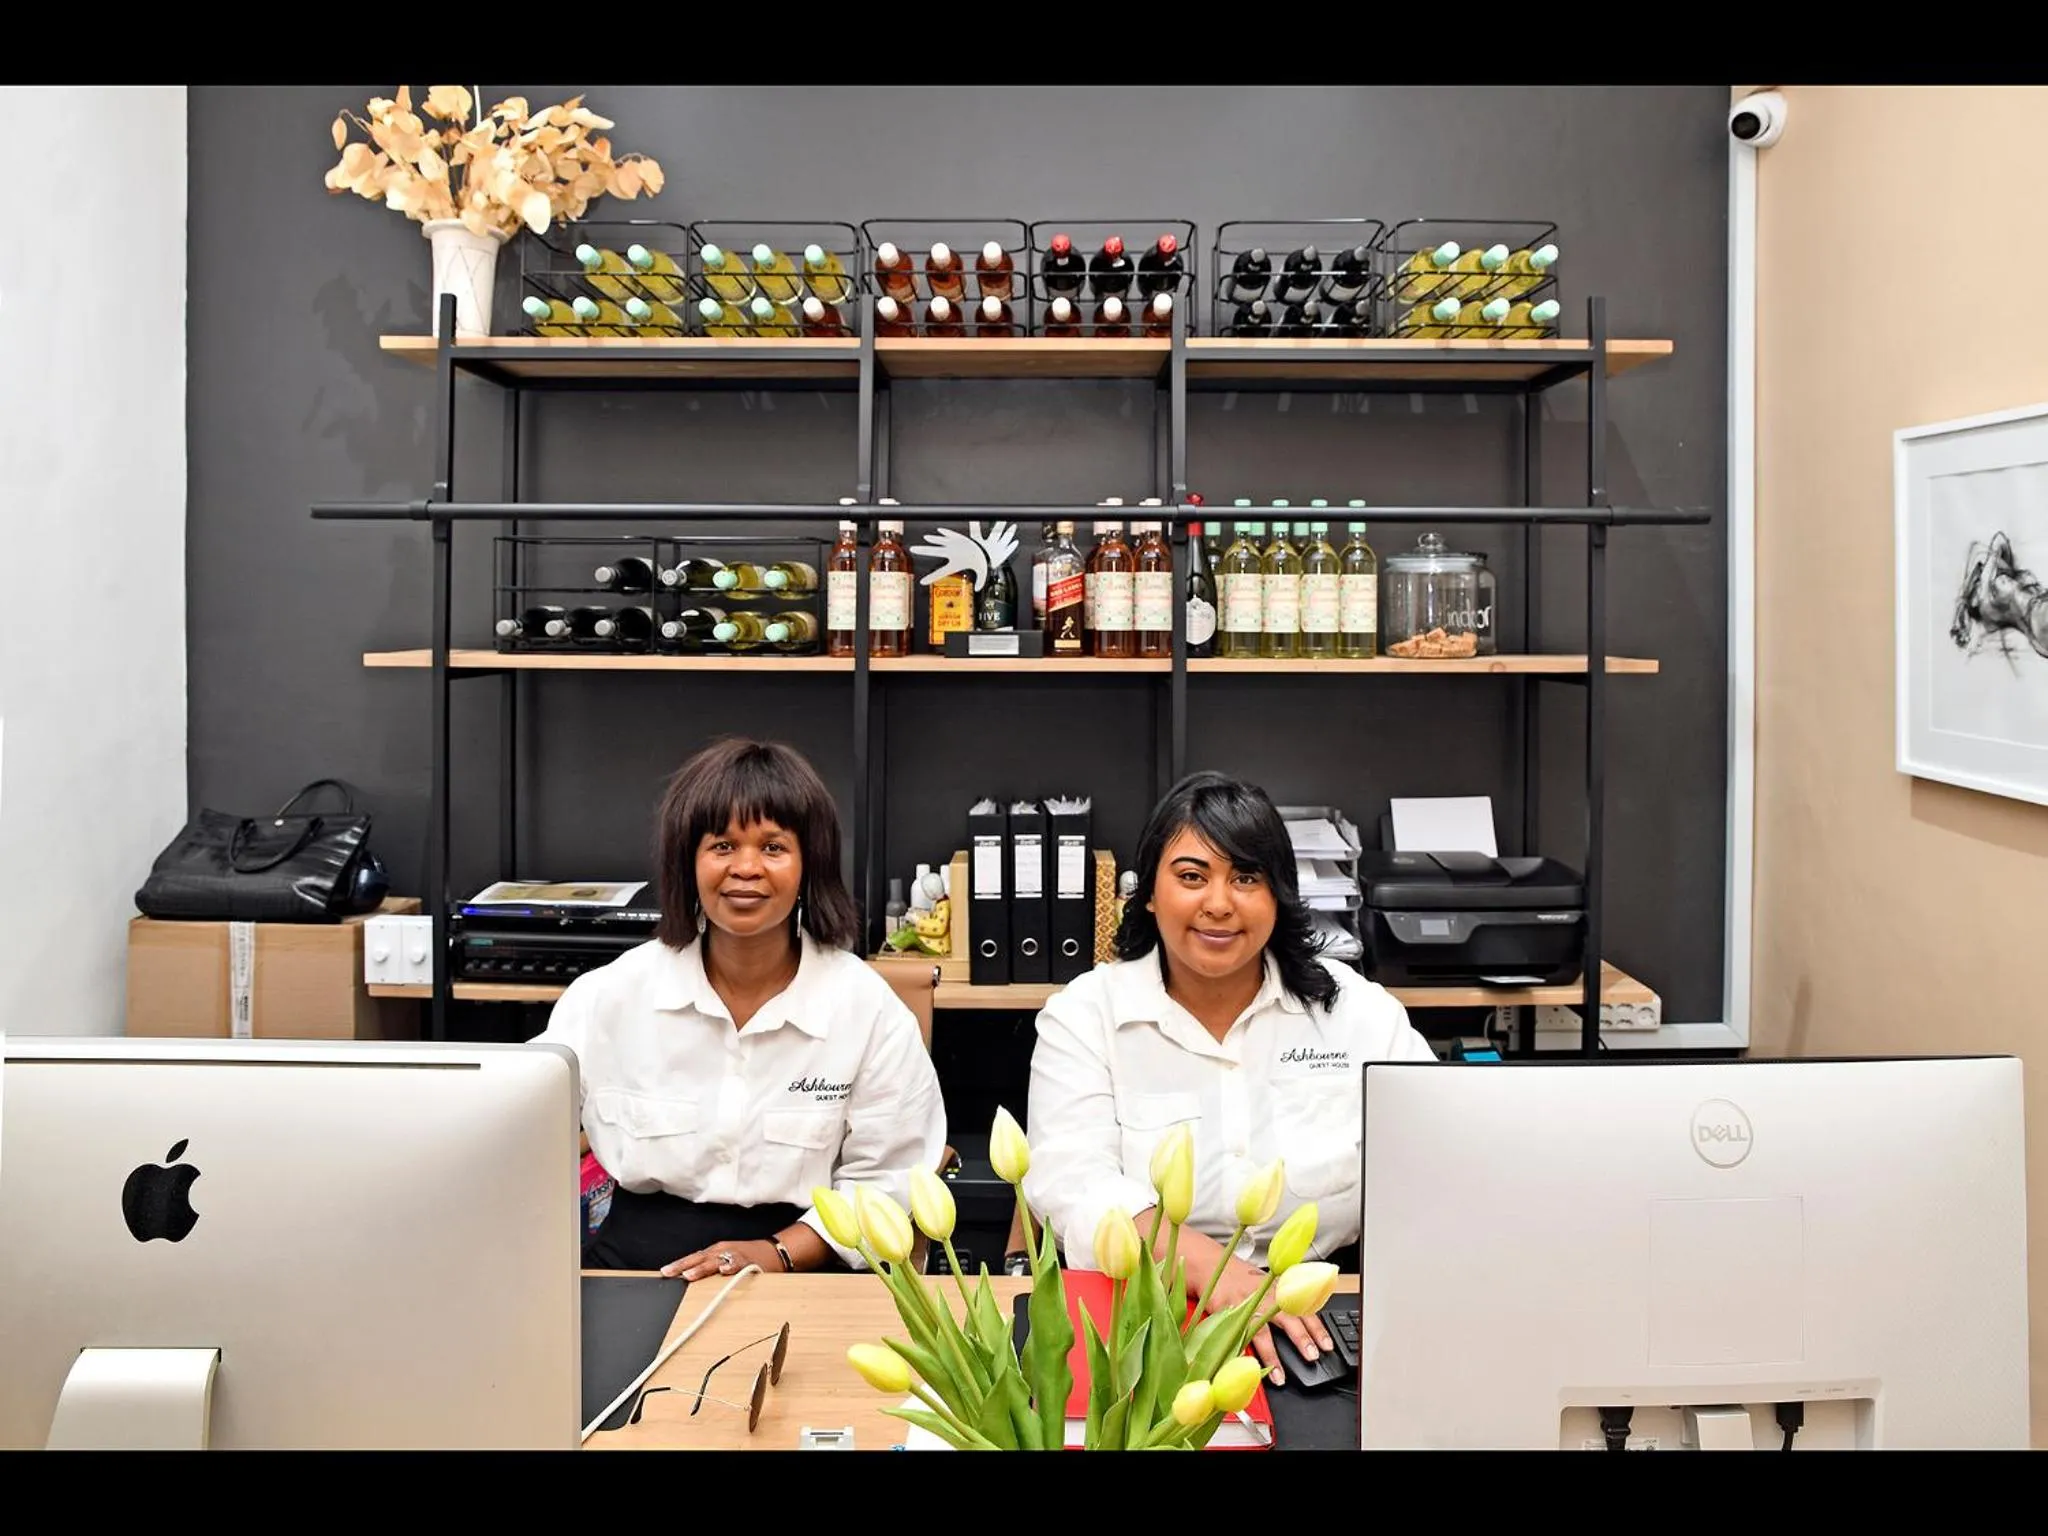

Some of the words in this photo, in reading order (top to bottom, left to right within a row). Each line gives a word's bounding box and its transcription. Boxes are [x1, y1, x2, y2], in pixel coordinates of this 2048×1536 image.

[1280, 1047, 1349, 1062] Ashbourne
[788, 1077, 852, 1092] Ashbourn
[1698, 1124, 1748, 1142] DELL
